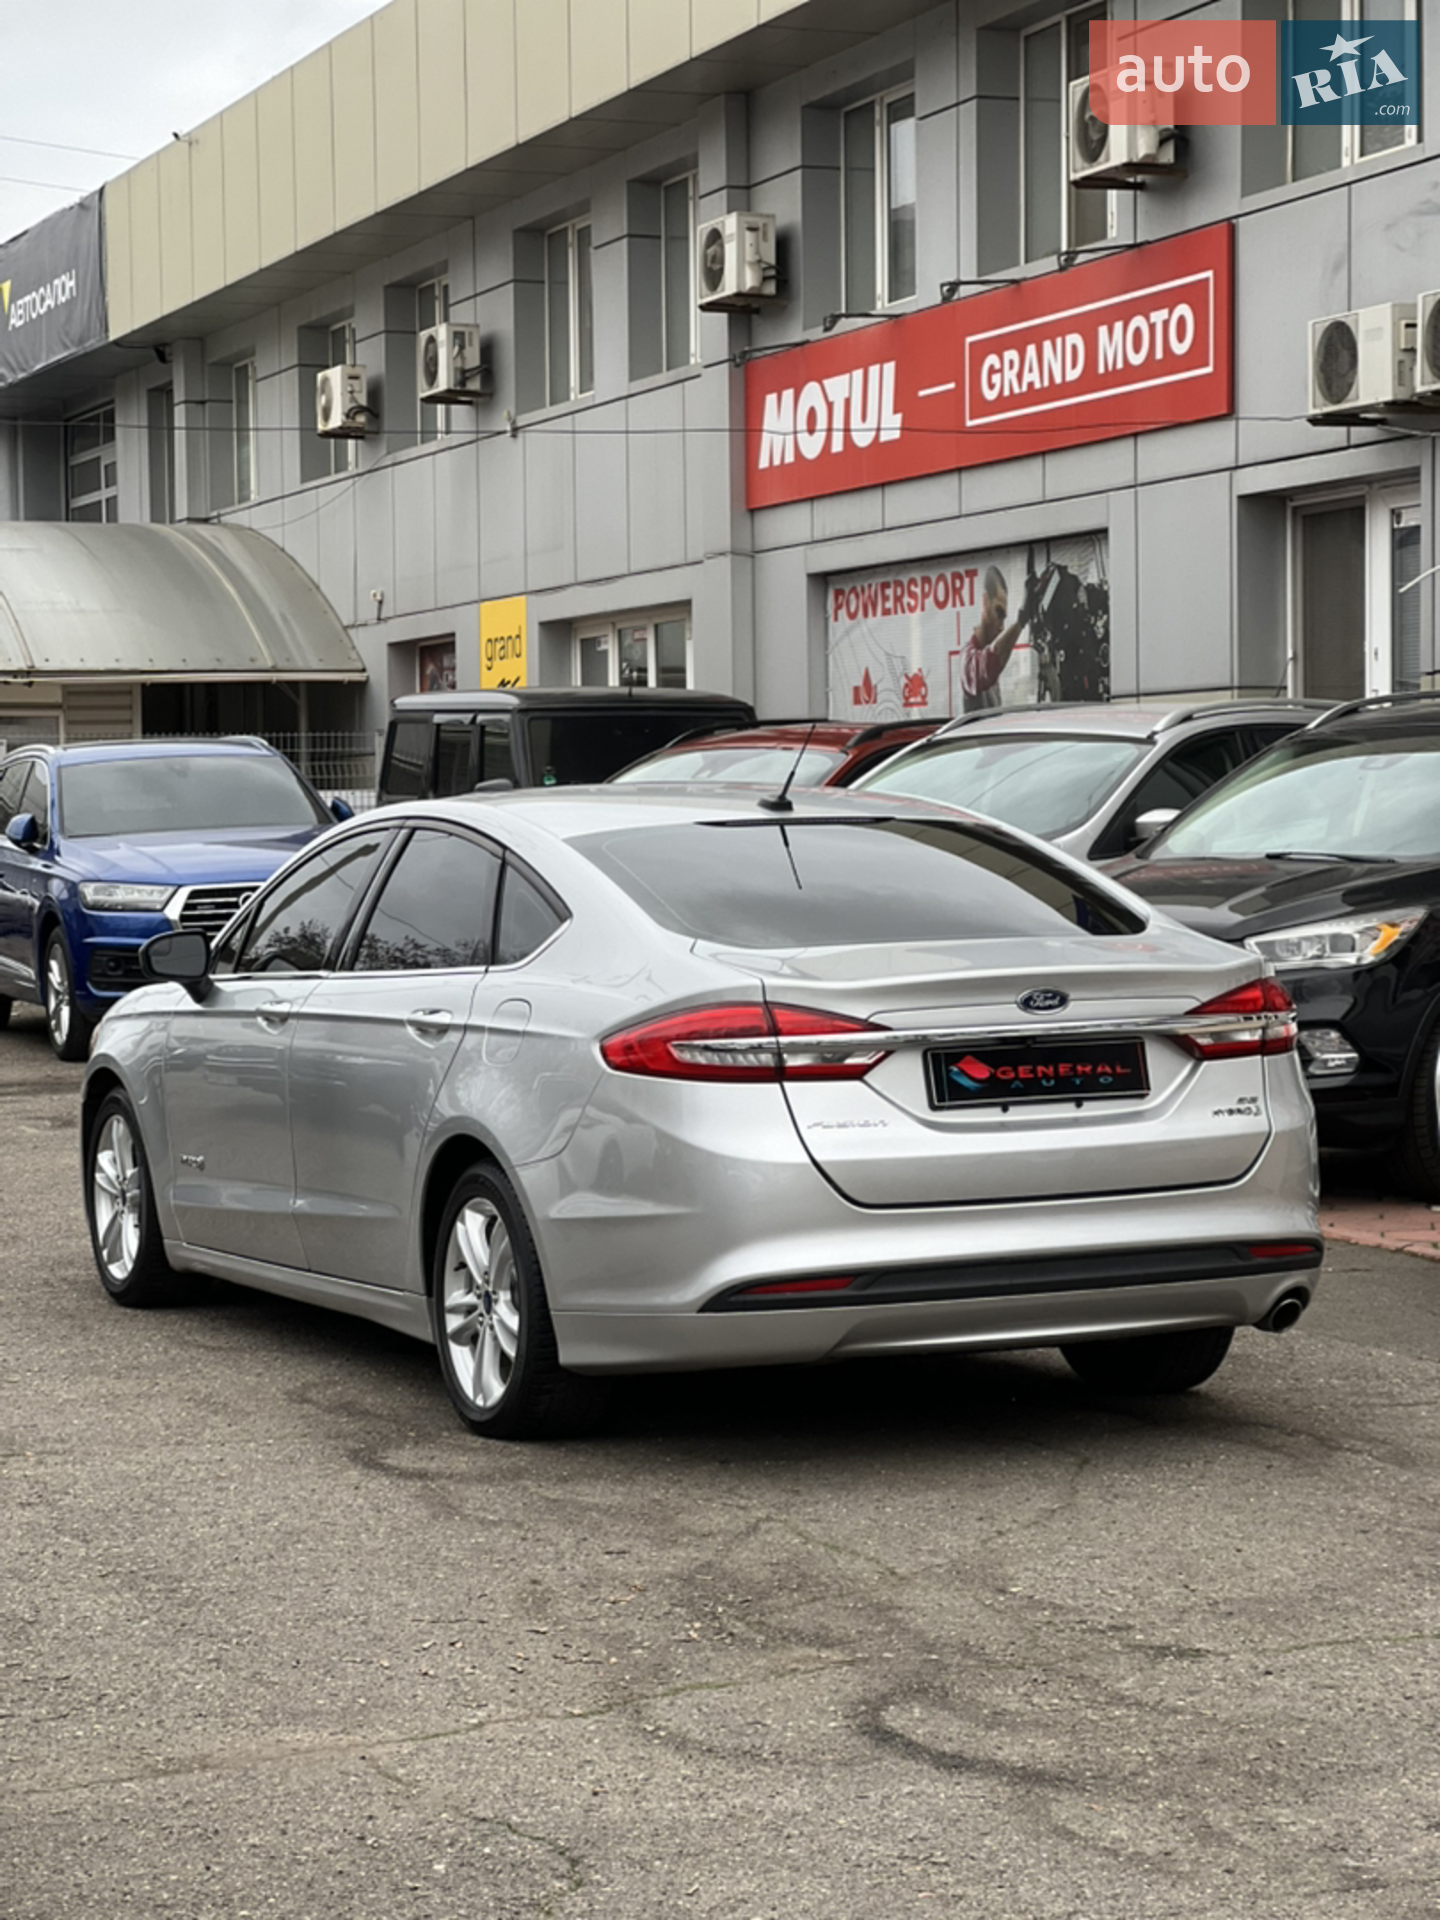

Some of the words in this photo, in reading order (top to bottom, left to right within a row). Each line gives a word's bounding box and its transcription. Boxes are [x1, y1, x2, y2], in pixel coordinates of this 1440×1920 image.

[8, 268, 77, 331] АВТОСАЛОН
[758, 361, 903, 470] MOTUL
[980, 333, 1085, 402] GRAND
[1097, 303, 1195, 374] MOTO
[832, 568, 979, 623] POWERSPORT
[485, 625, 522, 672] grand
[995, 1062, 1132, 1079] GENERAL
[1010, 1076, 1114, 1089] AUTO
